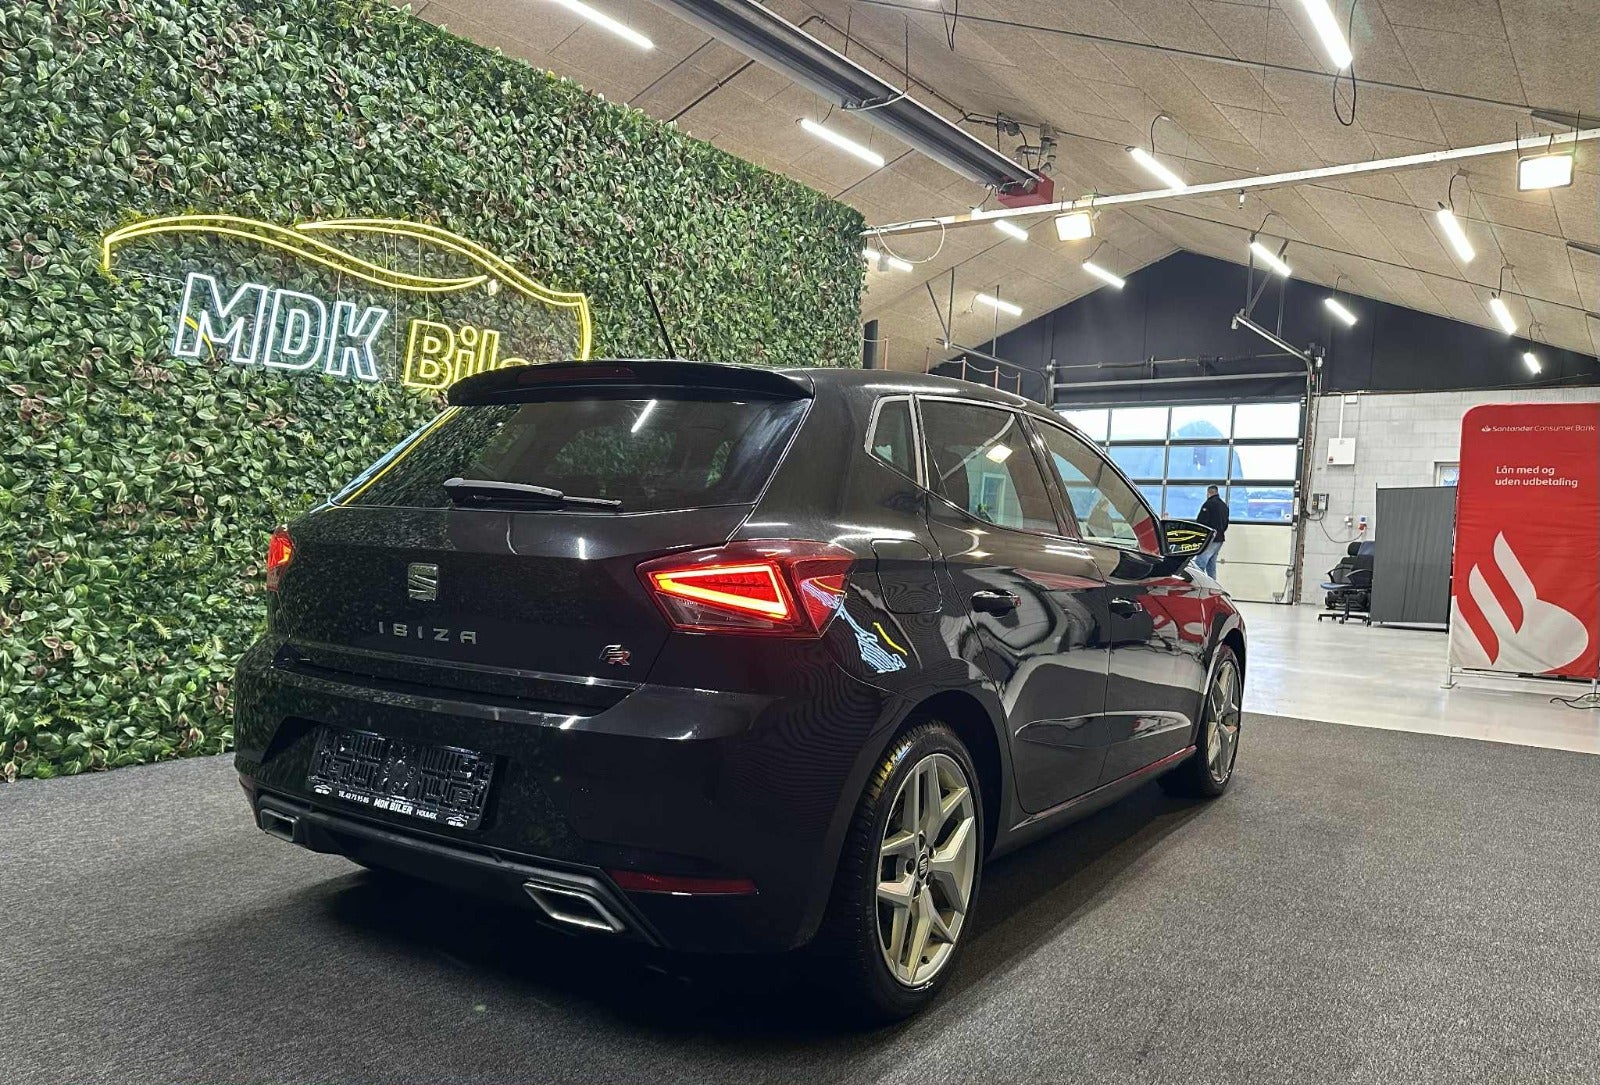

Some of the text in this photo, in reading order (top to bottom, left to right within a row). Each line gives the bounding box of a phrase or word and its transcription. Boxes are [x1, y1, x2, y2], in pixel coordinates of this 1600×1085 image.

[173, 272, 531, 390] MDK Bil
[1492, 425, 1533, 433] Santander
[1575, 424, 1596, 432] Bank
[1496, 465, 1555, 476] Lån med og
[1495, 477, 1578, 488] uden udbetaling
[378, 621, 477, 645] IBIZA
[389, 801, 414, 815] BILER
